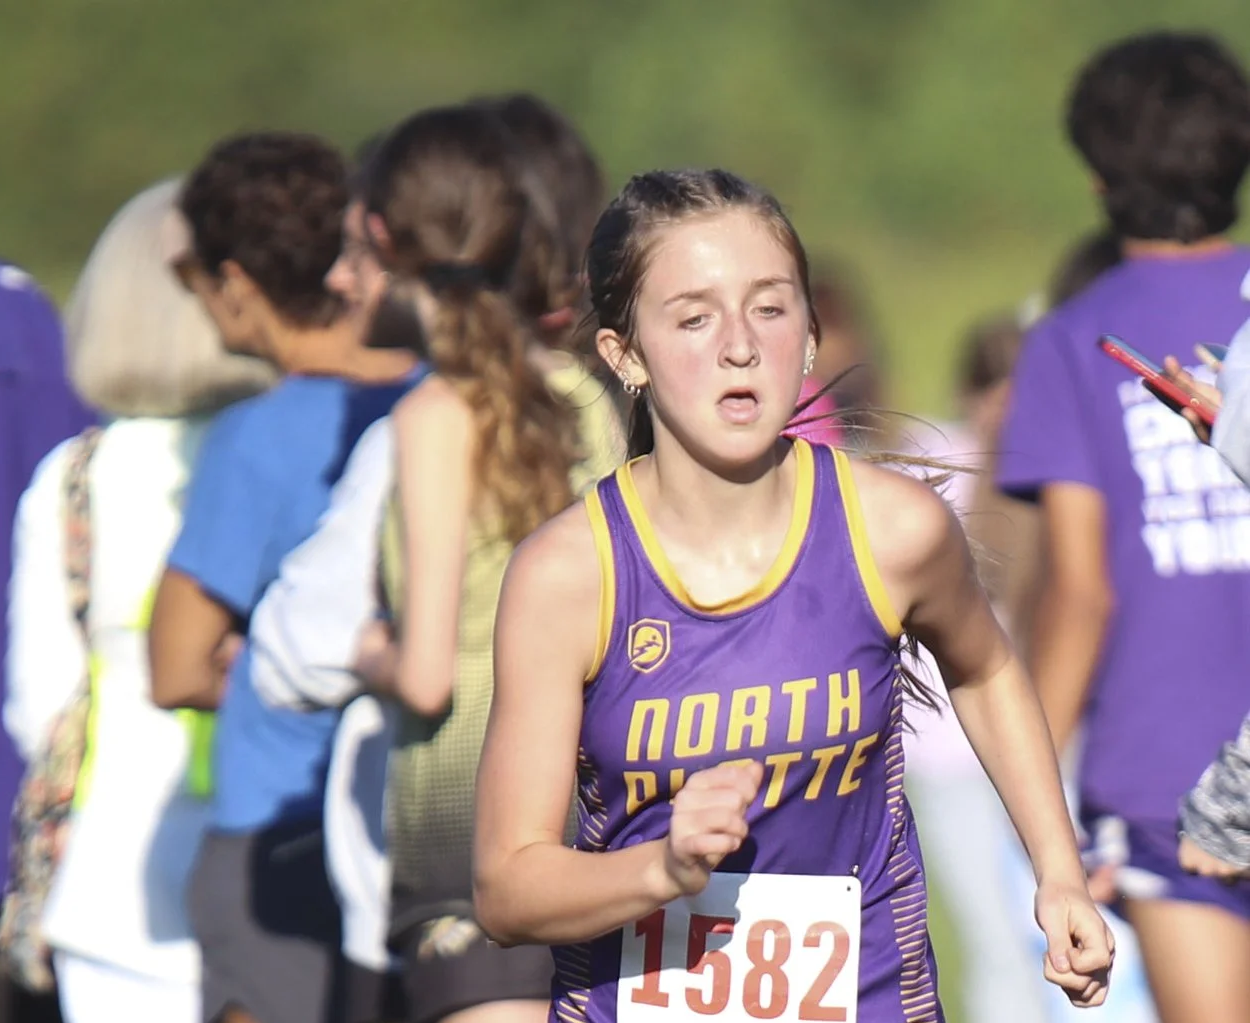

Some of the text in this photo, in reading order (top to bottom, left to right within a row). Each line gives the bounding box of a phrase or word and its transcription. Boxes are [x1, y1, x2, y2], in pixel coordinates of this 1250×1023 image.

[626, 669, 861, 762] NORTH
[623, 732, 879, 816] PTTE
[631, 908, 851, 1022] 1582
